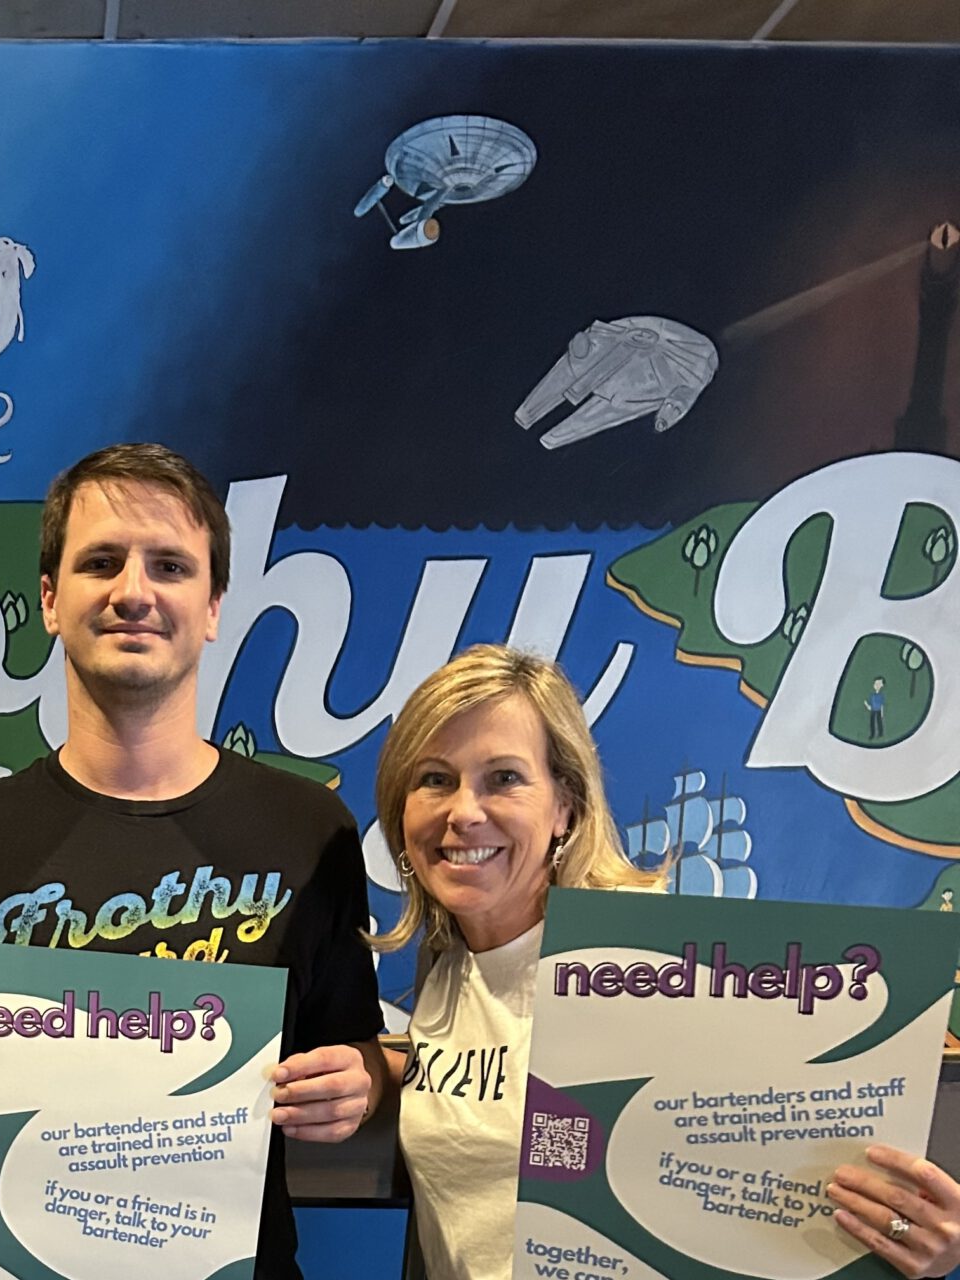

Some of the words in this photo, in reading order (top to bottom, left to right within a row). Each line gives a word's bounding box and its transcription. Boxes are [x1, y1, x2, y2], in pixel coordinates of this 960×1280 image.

[554, 942, 697, 998] need
[709, 942, 882, 1015] help?
[86, 990, 225, 1053] help?
[654, 1098, 688, 1111] our
[693, 1087, 806, 1109] bartenders
[810, 1081, 851, 1101] and
[857, 1077, 906, 1099] staff
[41, 1127, 71, 1141] our
[74, 1117, 169, 1139] bartenders
[172, 1112, 206, 1130] and
[210, 1107, 249, 1126] staff
[674, 1114, 708, 1128] are
[713, 1106, 786, 1126] trained
[791, 1105, 810, 1121] in
[815, 1099, 884, 1120] sexual
[58, 1143, 88, 1156] are
[91, 1133, 153, 1153] trained
[157, 1133, 173, 1149] in
[176, 1126, 232, 1146] sexual
[686, 1125, 756, 1145] assault
[761, 1121, 875, 1146] prevention
[68, 1153, 128, 1172] assault
[131, 1146, 225, 1171] prevention
[659, 1152, 675, 1168] if
[675, 1157, 712, 1175] you
[716, 1166, 739, 1181] or
[743, 1172, 756, 1185] a
[761, 1170, 821, 1197] friend
[45, 1180, 58, 1196] if
[59, 1185, 91, 1202] you
[94, 1192, 114, 1206] or
[116, 1197, 128, 1209] a
[131, 1195, 182, 1217] friend
[184, 1204, 197, 1220] is
[200, 1207, 216, 1224] in
[659, 1171, 737, 1201] danger,
[741, 1186, 779, 1207] talk
[784, 1194, 804, 1212] to
[45, 1200, 111, 1225] danger,
[115, 1210, 148, 1229] talk
[150, 1217, 167, 1233] to
[170, 1222, 212, 1239] your
[703, 1196, 804, 1228] bartender
[82, 1220, 168, 1249] bartender
[526, 1238, 629, 1276] together,
[535, 1263, 570, 1280] we
